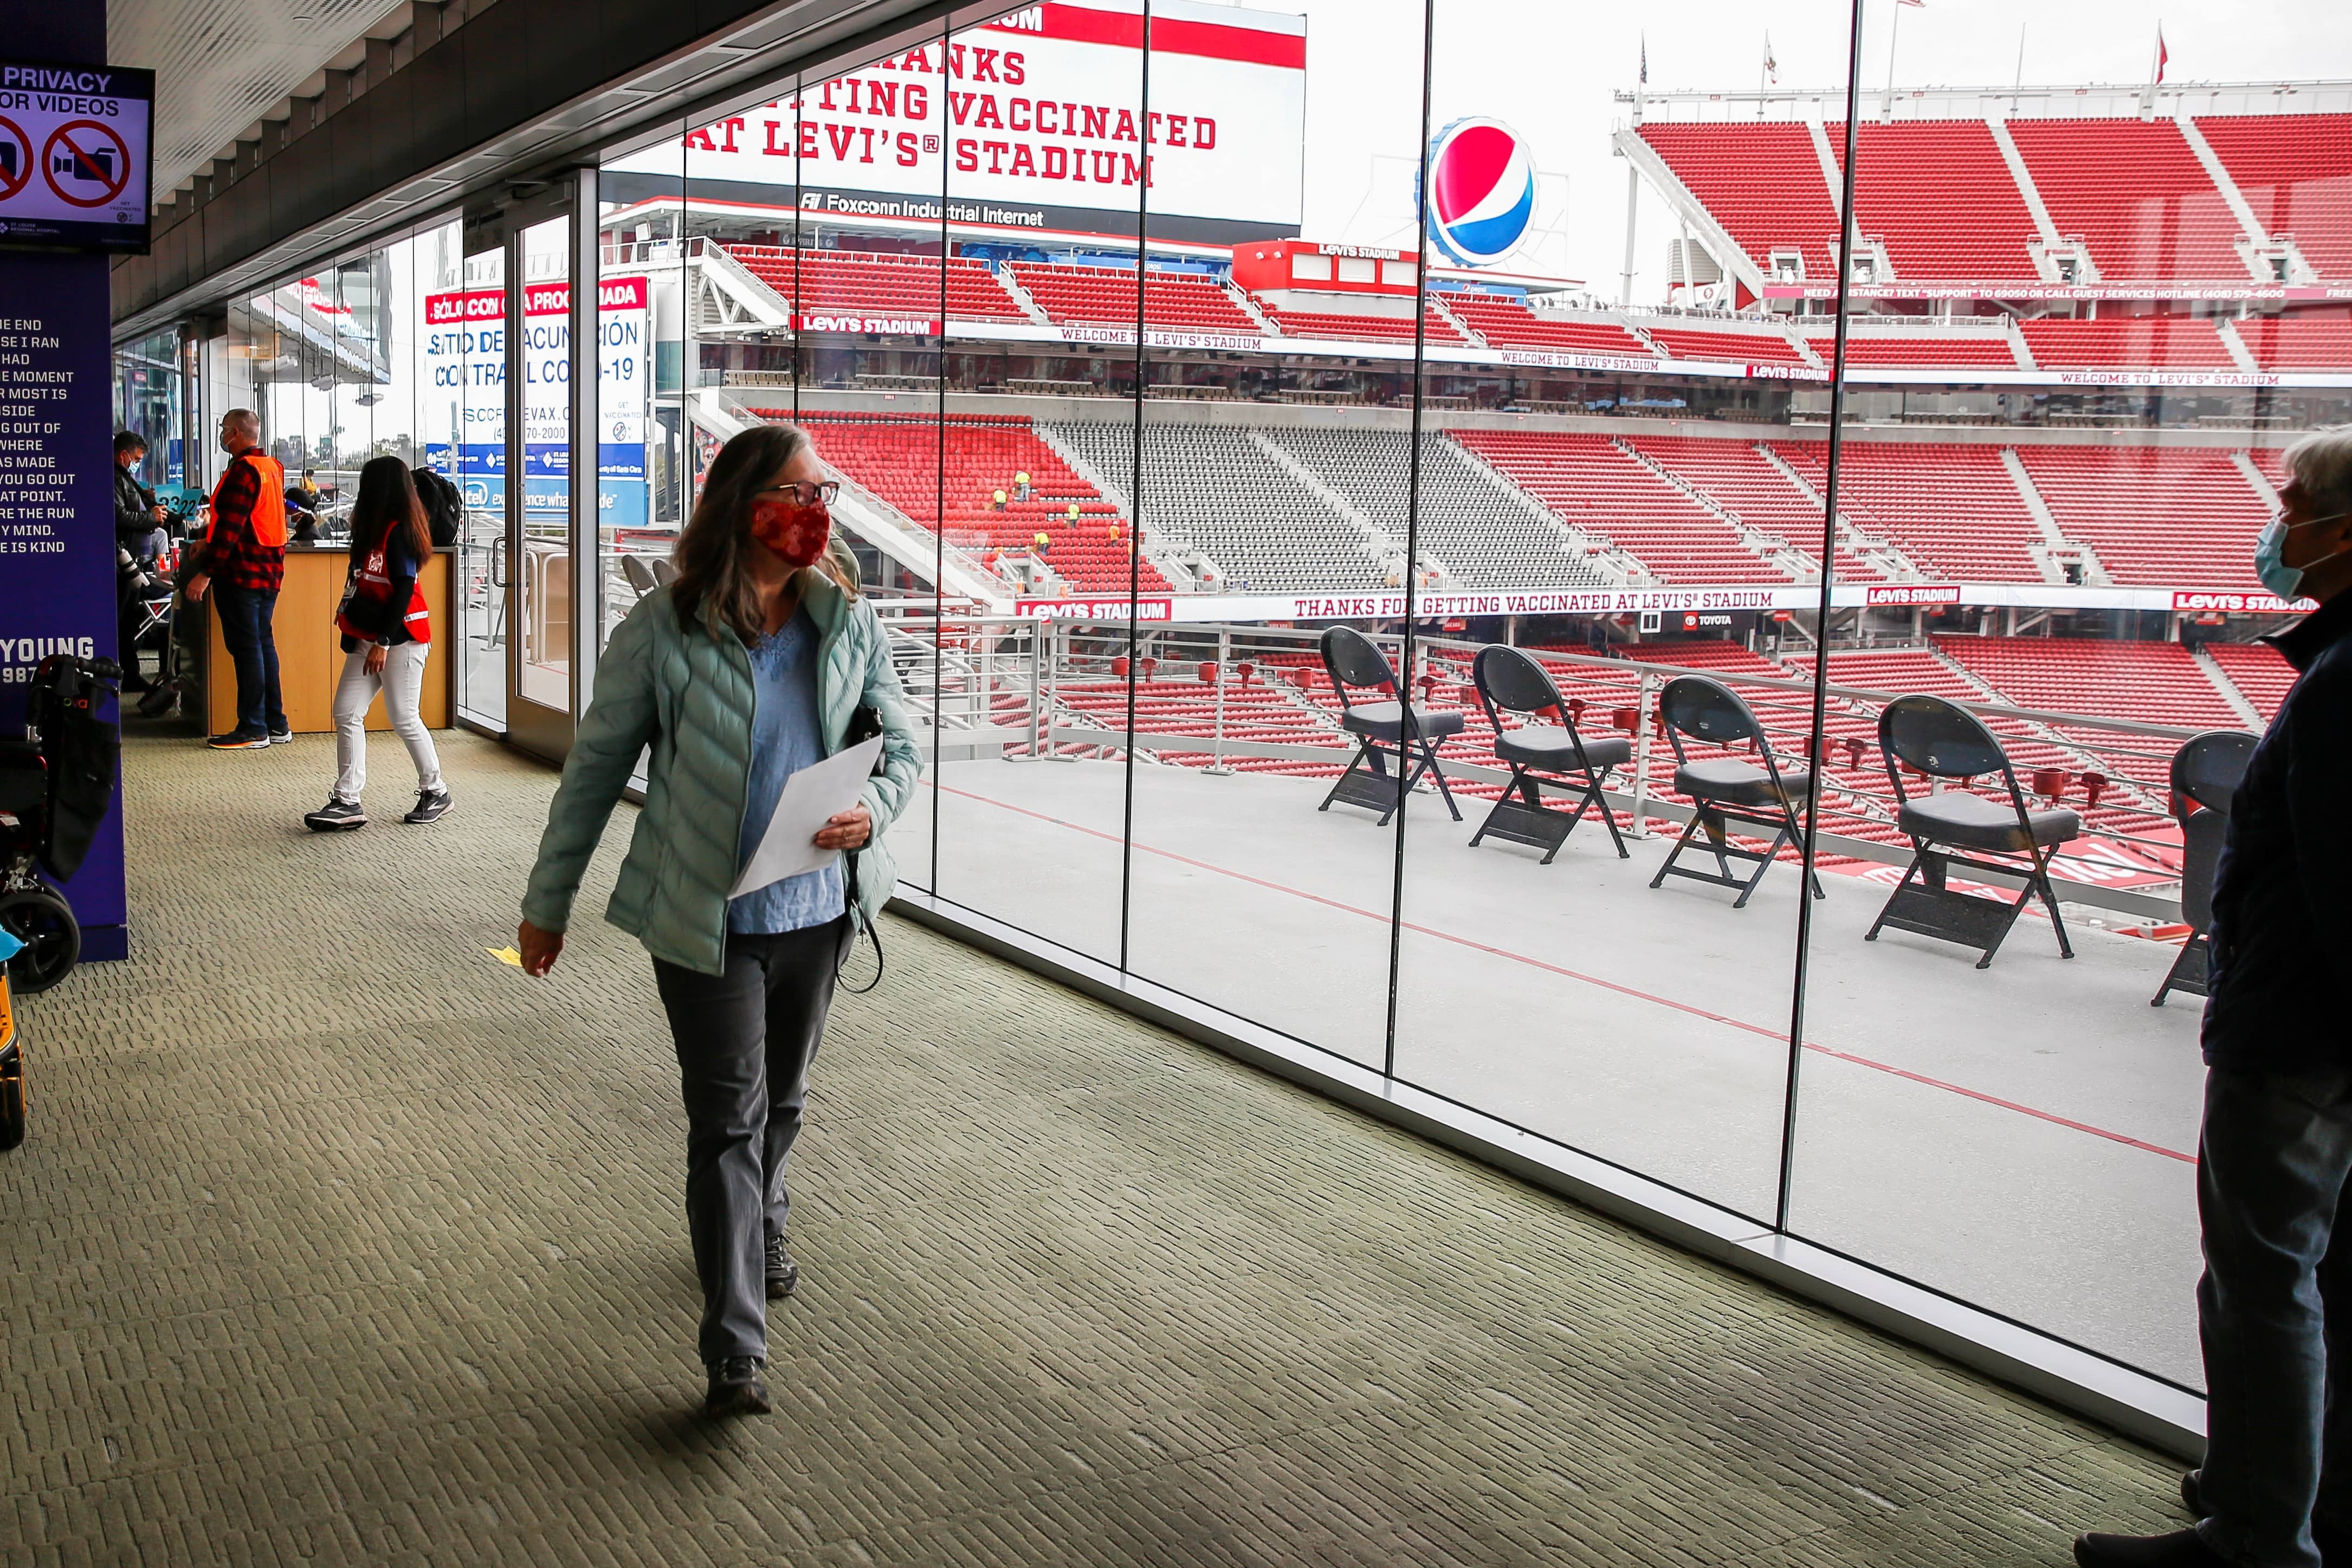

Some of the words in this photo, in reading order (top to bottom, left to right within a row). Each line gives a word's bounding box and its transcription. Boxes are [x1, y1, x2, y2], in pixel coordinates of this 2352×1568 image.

[4, 67, 112, 93] PRIVACY
[0, 92, 30, 111] OR
[36, 94, 119, 116] VIDEOS
[947, 90, 1216, 150] VACCINATED
[956, 139, 1154, 188] STADIUM
[826, 193, 901, 216] Foxconn
[902, 200, 979, 222] Industrial
[983, 205, 1044, 227] Internet
[1359, 248, 1400, 260] STADIUM
[1470, 286, 1487, 294] pepsi
[1803, 288, 1831, 297] NEED
[1832, 288, 1894, 298] AISTANCE?
[1895, 289, 1920, 297] TEXT
[1979, 289, 1993, 297] TO
[1994, 289, 2028, 298] 69050
[2029, 289, 2044, 298] OR
[2045, 289, 2071, 298] CALL
[2072, 289, 2105, 298] GUEST
[2105, 289, 2155, 298] SERVICES
[2157, 289, 2201, 299] HOTLINE
[2202, 289, 2232, 299] (408)
[2233, 289, 2285, 299] 579-4600
[466, 297, 498, 316] CON
[15, 319, 42, 331] END
[864, 320, 930, 335] STADIUM
[21, 337, 27, 347] I
[31, 337, 59, 348] RAN
[480, 330, 503, 353] DE
[1061, 329, 1127, 342] WELCOME
[1204, 336, 1262, 349] STADIUM
[2, 354, 30, 365] HAD
[1502, 352, 1553, 365] WELCOME
[1556, 355, 1569, 366] TO
[1613, 358, 1659, 371] STADIUM
[0, 371, 9, 381] E
[14, 371, 74, 383] MOMENT
[1789, 368, 1830, 380] STADIUM
[2061, 374, 2129, 384] WELCOME
[2135, 374, 2150, 384] TO
[2214, 375, 2280, 385] STADIUM
[9, 388, 48, 399] MOST
[52, 389, 67, 400] IS
[0, 405, 35, 416] SIDE
[14, 423, 41, 433] OUT
[44, 423, 61, 433] OF
[0, 440, 43, 451] WHERE
[17, 457, 55, 468] MADE
[27, 474, 44, 484] GO
[49, 474, 75, 485] OUT
[20, 491, 66, 502] POINT.
[17, 508, 43, 519] THE
[47, 508, 74, 519] RUN
[178, 500, 197, 516] 22
[14, 525, 55, 536] MIND.
[11, 542, 26, 553] IS
[30, 542, 64, 553] KIND
[1910, 588, 1958, 602] STADIUM
[1295, 599, 1375, 617] THANKS
[1423, 597, 1500, 614] GETTING
[1507, 594, 1611, 612] VACCINATED
[1617, 594, 1638, 610] AT
[1702, 592, 1773, 608] STADIUM
[1698, 615, 1732, 625] TOYOTA
[0, 637, 94, 662] YOUNG
